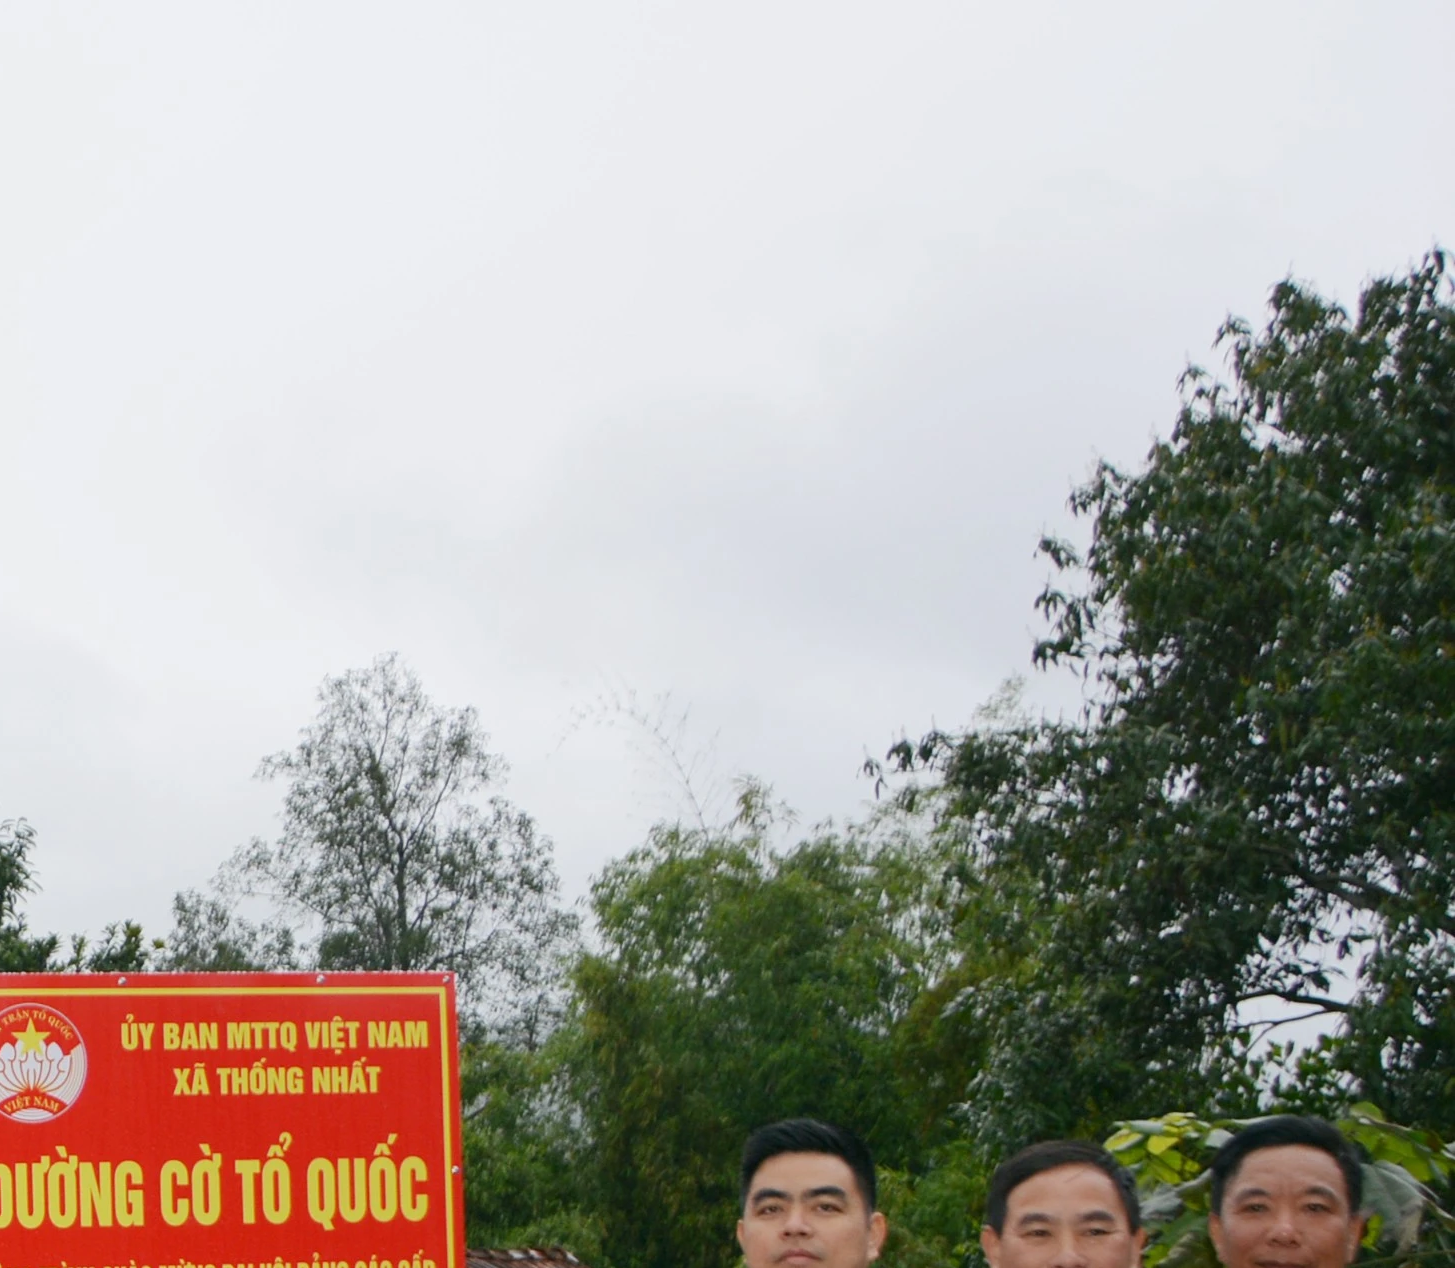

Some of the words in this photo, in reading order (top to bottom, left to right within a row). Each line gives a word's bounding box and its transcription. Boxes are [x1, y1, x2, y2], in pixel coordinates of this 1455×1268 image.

[120, 1013, 155, 1050] ỦY
[163, 1022, 218, 1050] BAN
[226, 1021, 297, 1052] MTTQ
[304, 1016, 360, 1055] VIỆT
[367, 1020, 428, 1049] NAM
[173, 1062, 210, 1096] XÃ
[216, 1057, 304, 1095] THỐNG
[312, 1056, 381, 1094] NHẤT
[33, 1096, 60, 1112] NAM
[160, 1143, 222, 1226] CỜ
[235, 1131, 293, 1225] TỔ
[306, 1133, 429, 1231] QUỐC
